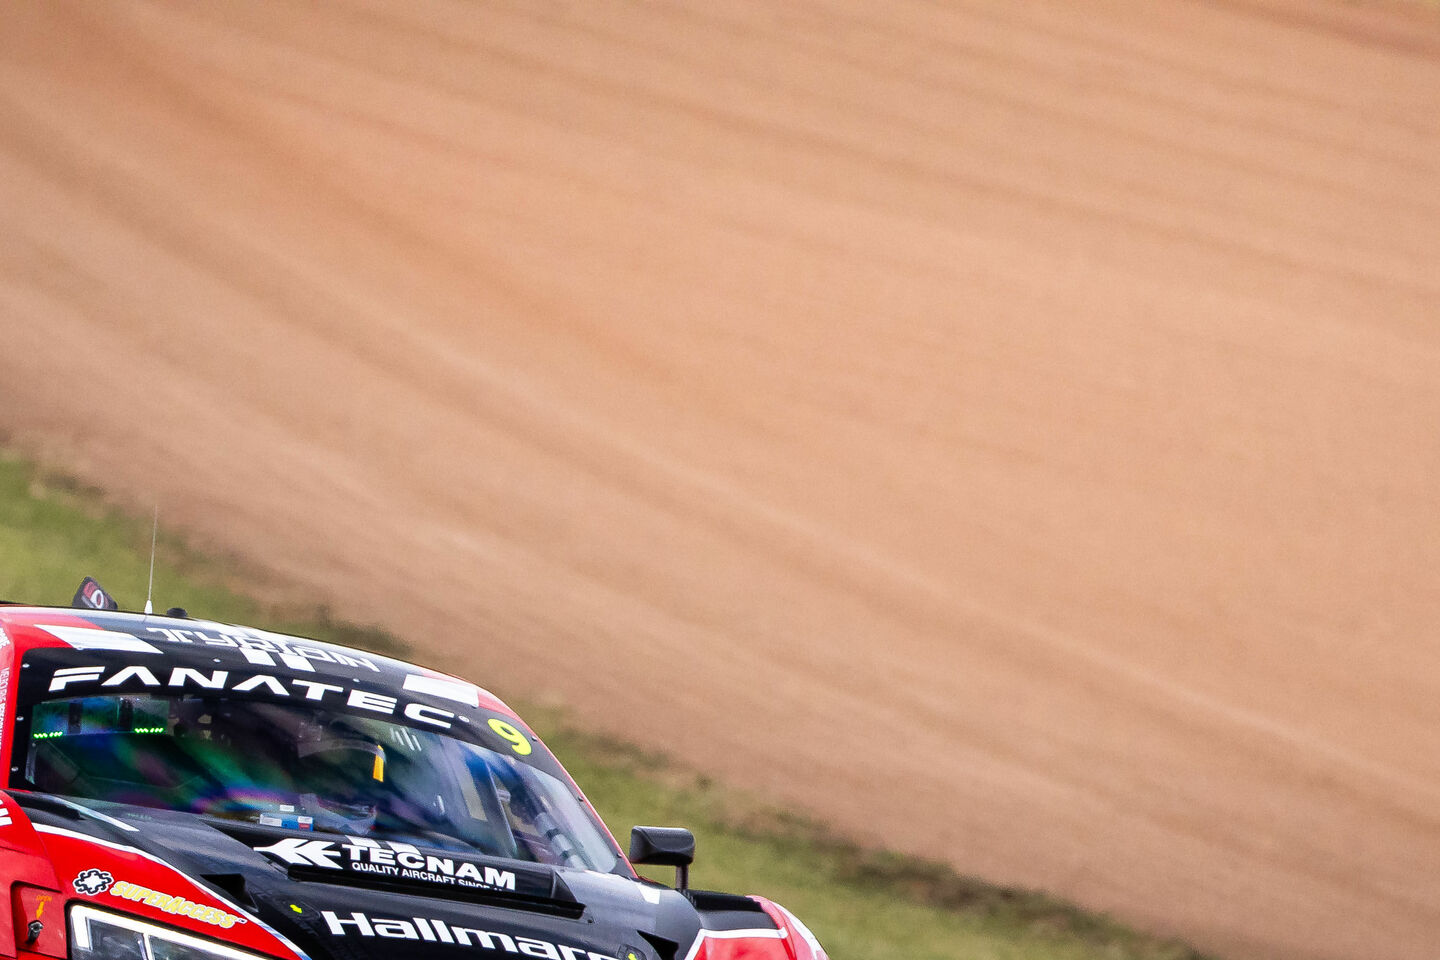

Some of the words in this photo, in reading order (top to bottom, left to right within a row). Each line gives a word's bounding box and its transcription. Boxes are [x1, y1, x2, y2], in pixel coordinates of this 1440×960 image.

[48, 665, 458, 730] FANATEC
[487, 717, 533, 756] 9
[341, 843, 516, 890] TECNAM
[352, 862, 400, 876] QUALITY
[402, 868, 456, 885] AIRCRAFT
